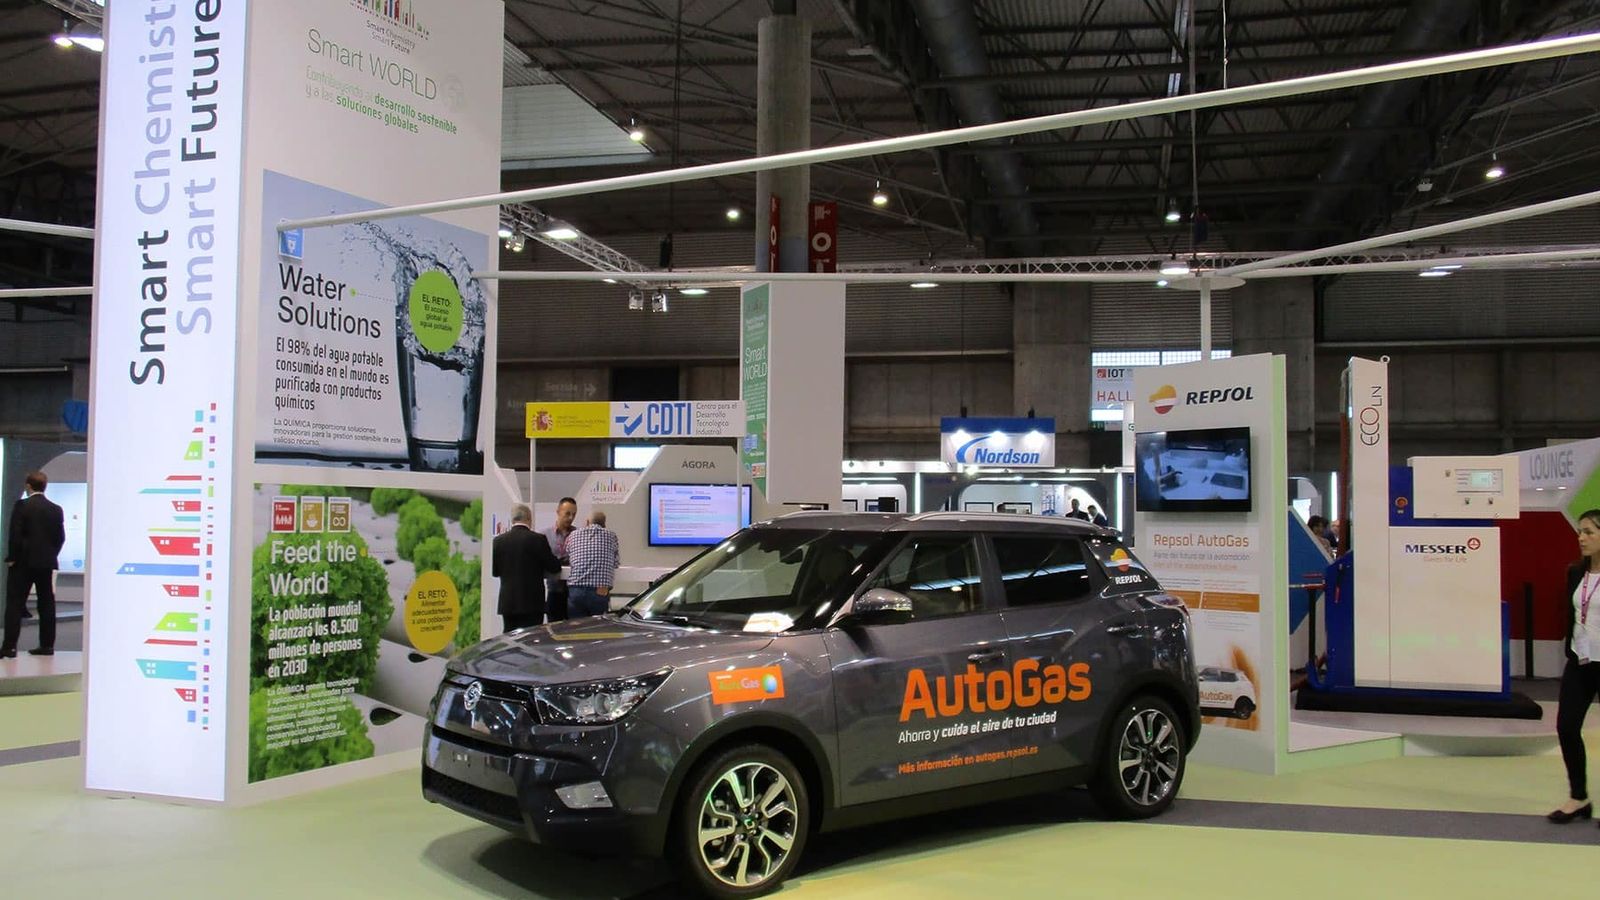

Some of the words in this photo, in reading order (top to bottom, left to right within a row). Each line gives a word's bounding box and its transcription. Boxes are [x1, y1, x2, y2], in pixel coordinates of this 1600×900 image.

[308, 28, 363, 72] Smart
[369, 53, 437, 100] WORLD
[181, 0, 222, 162] Future
[336, 95, 382, 120] soluciones
[385, 112, 419, 134] globales
[375, 92, 416, 118] desarrollo
[417, 110, 457, 134] sostenible
[176, 177, 216, 335] Smart
[278, 262, 346, 301] Water
[130, 230, 169, 385] Smart
[422, 294, 430, 303] EL
[278, 296, 381, 338] Solutions
[276, 336, 285, 352] El
[288, 339, 310, 356] 98%
[313, 344, 327, 358] del
[329, 348, 350, 364] agua
[352, 350, 384, 367] potable
[276, 359, 324, 376] consumida
[326, 366, 337, 378] en
[340, 366, 348, 379] el
[350, 369, 378, 384] mundo
[380, 374, 390, 385] es
[1108, 368, 1125, 378] IOT
[275, 376, 320, 394] purificada
[323, 384, 338, 396] con
[340, 384, 382, 400] productos
[1097, 390, 1133, 402] HALL
[1186, 386, 1254, 405] REPSOL
[696, 402, 716, 410] Centro
[647, 402, 692, 435] CDTI
[974, 448, 1040, 464] Nordson
[1530, 450, 1574, 480] LOUNGE
[272, 540, 320, 564] Feed
[326, 540, 356, 562] the
[1154, 534, 1193, 548] Repsol
[1197, 534, 1249, 548] AutoGas
[1405, 544, 1466, 554] MESSER
[270, 570, 328, 596] World
[1115, 574, 1142, 585] REPSOL
[418, 591, 426, 599] EL
[269, 606, 280, 622] La
[283, 603, 326, 624] población
[328, 600, 362, 618] mundial
[268, 622, 313, 640] alcanzará
[315, 622, 328, 636] los
[330, 618, 358, 635] 8.500
[268, 642, 308, 660] millones
[309, 640, 320, 655] de
[322, 638, 362, 658] personas
[268, 666, 280, 678] en
[282, 659, 308, 676] 2030
[899, 658, 1092, 722] AutoGas
[898, 730, 930, 744] Ahorra
[932, 728, 940, 742] y
[942, 723, 968, 738] cuida
[970, 721, 980, 734] el
[982, 719, 1000, 732] aire
[1002, 716, 1013, 730] de
[1015, 716, 1025, 728] tu
[1026, 711, 1058, 726] ciudad
[898, 762, 916, 774] Más
[916, 754, 963, 772] información
[964, 755, 974, 764] en
